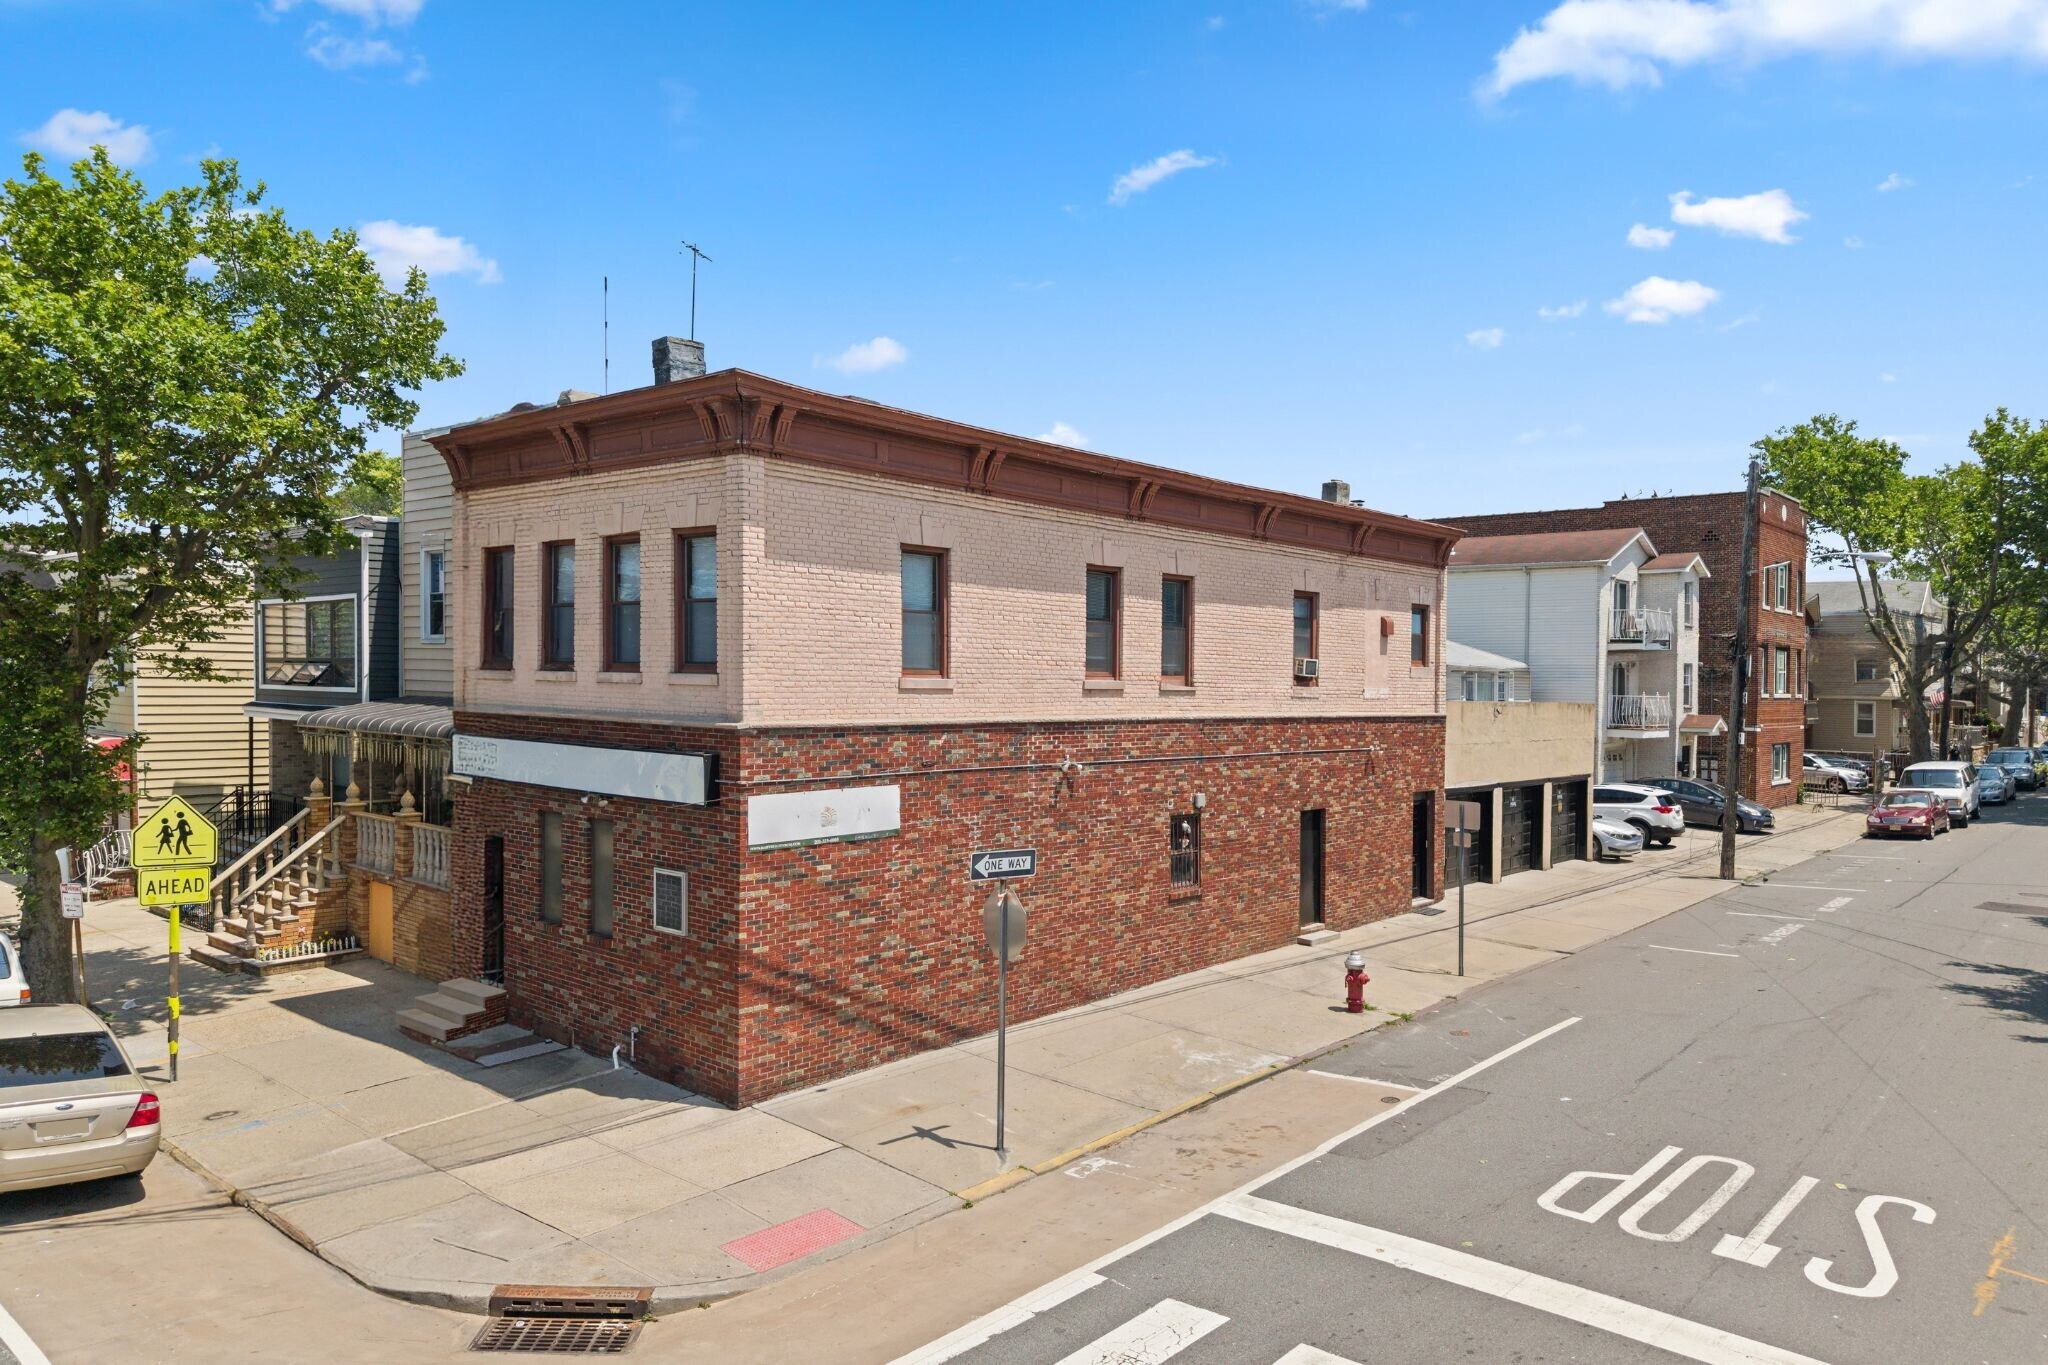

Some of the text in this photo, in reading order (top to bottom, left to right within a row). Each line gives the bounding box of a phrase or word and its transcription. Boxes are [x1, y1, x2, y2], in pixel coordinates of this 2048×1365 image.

[984, 858, 1027, 871] ONE WAY
[145, 878, 205, 895] AHEAD
[1537, 1145, 1937, 1297] STOP
